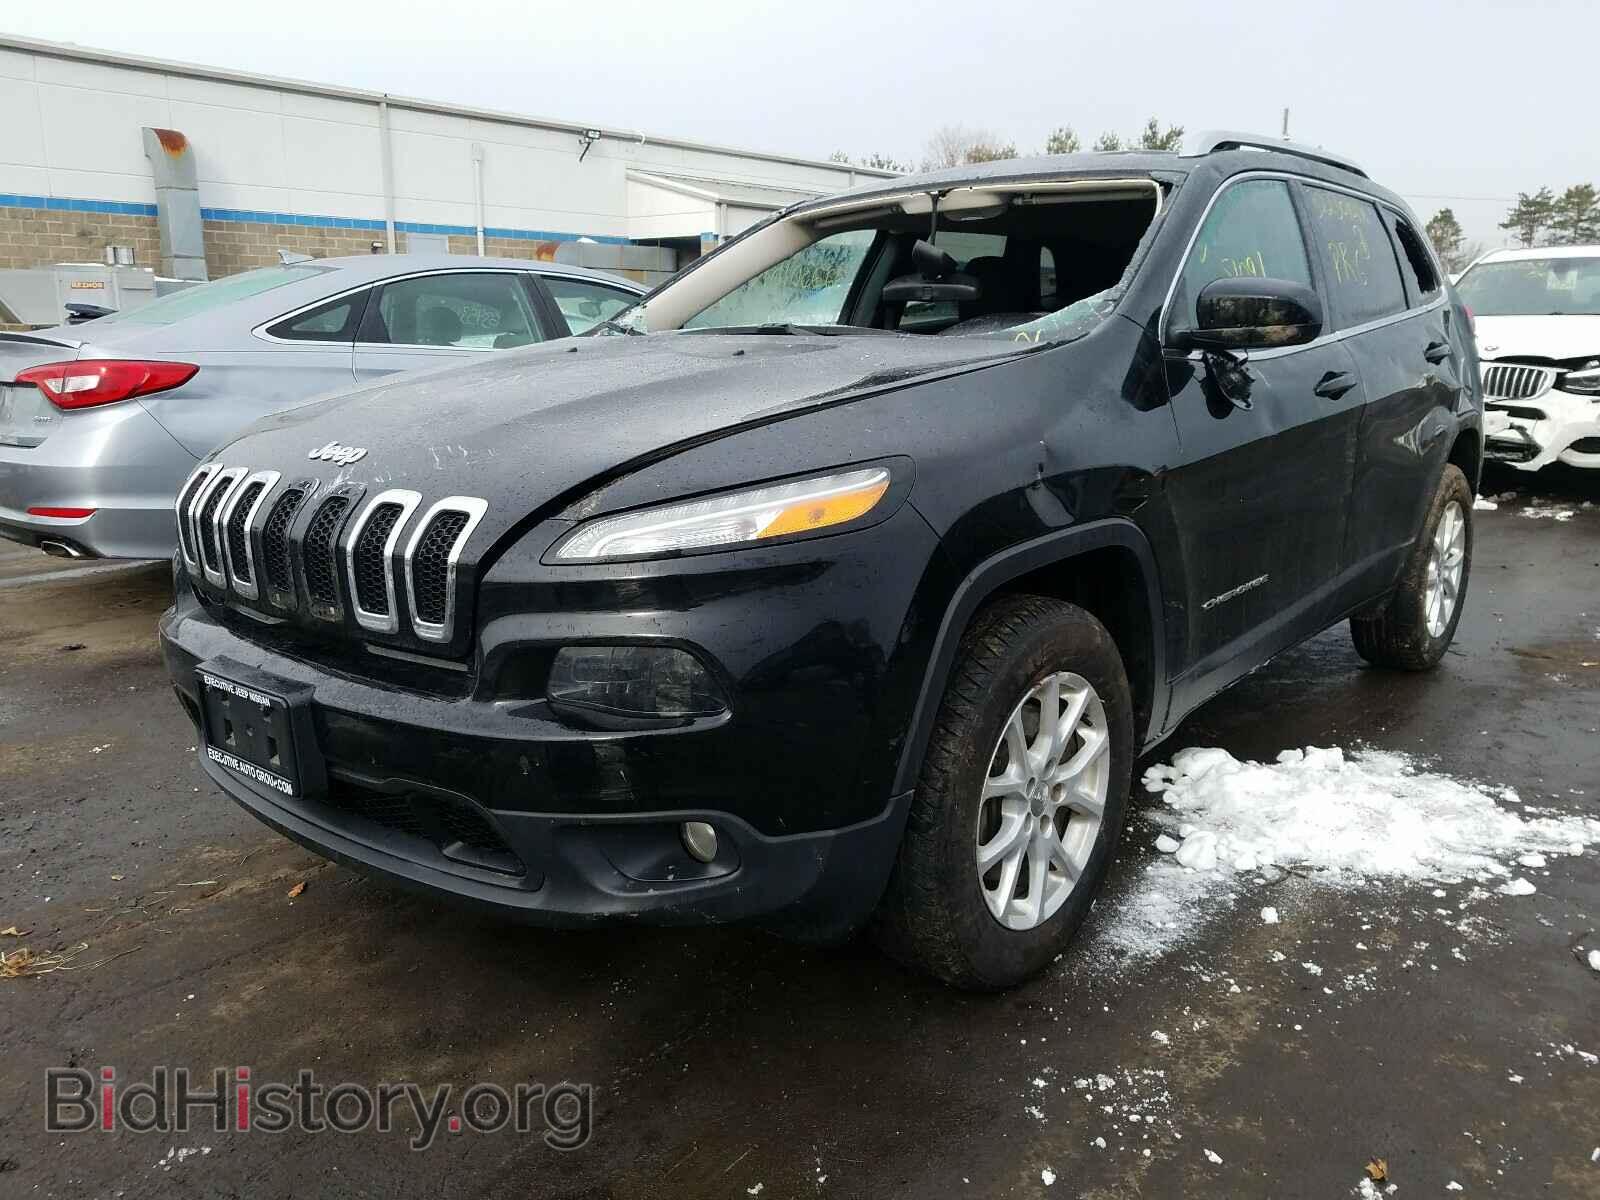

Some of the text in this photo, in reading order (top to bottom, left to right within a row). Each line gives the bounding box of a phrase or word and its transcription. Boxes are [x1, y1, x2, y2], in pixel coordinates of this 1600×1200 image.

[308, 441, 368, 467] Jeep
[203, 674, 271, 707] EXECUTIVE JEEP NISSAN
[207, 747, 240, 771] EXECUTIVE
[239, 762, 256, 779] AUTO
